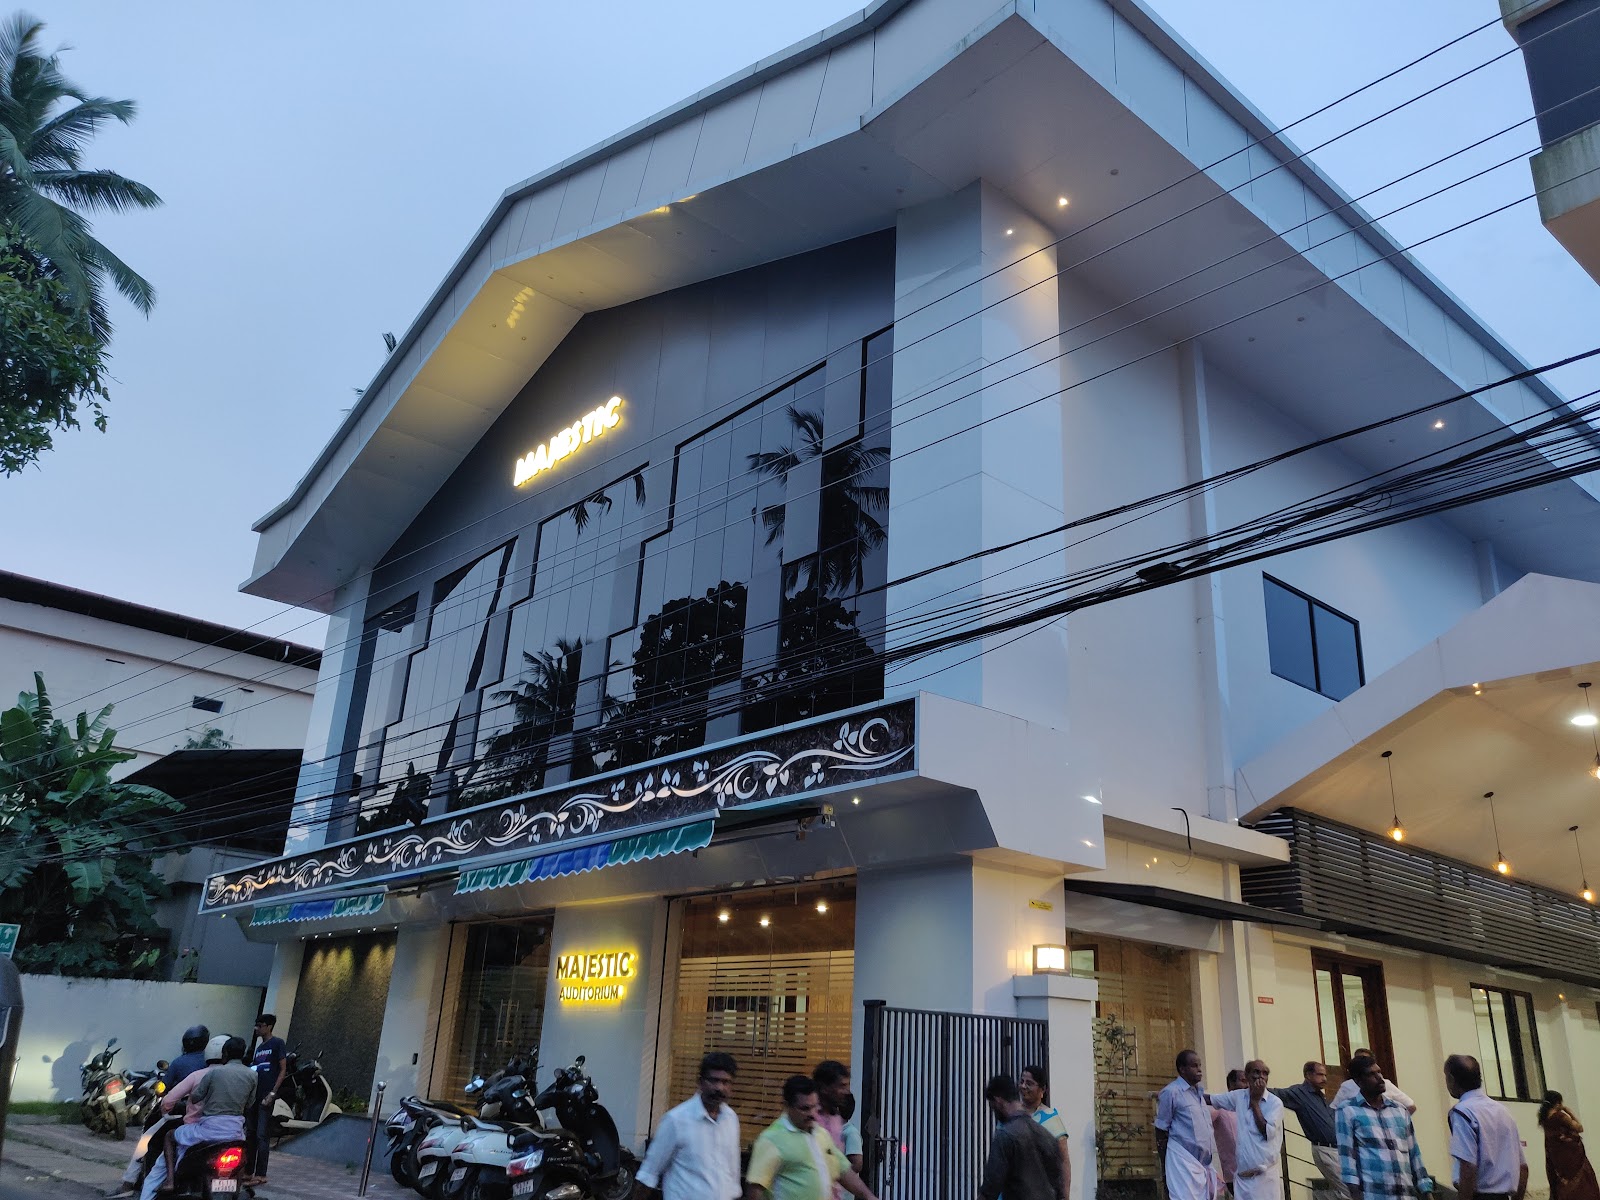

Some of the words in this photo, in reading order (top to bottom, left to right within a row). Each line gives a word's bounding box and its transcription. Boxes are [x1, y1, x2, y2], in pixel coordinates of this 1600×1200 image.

[513, 396, 623, 487] MAJESTIC
[556, 952, 632, 982] MAJESTIC
[559, 984, 619, 1001] AUDITORIUM
